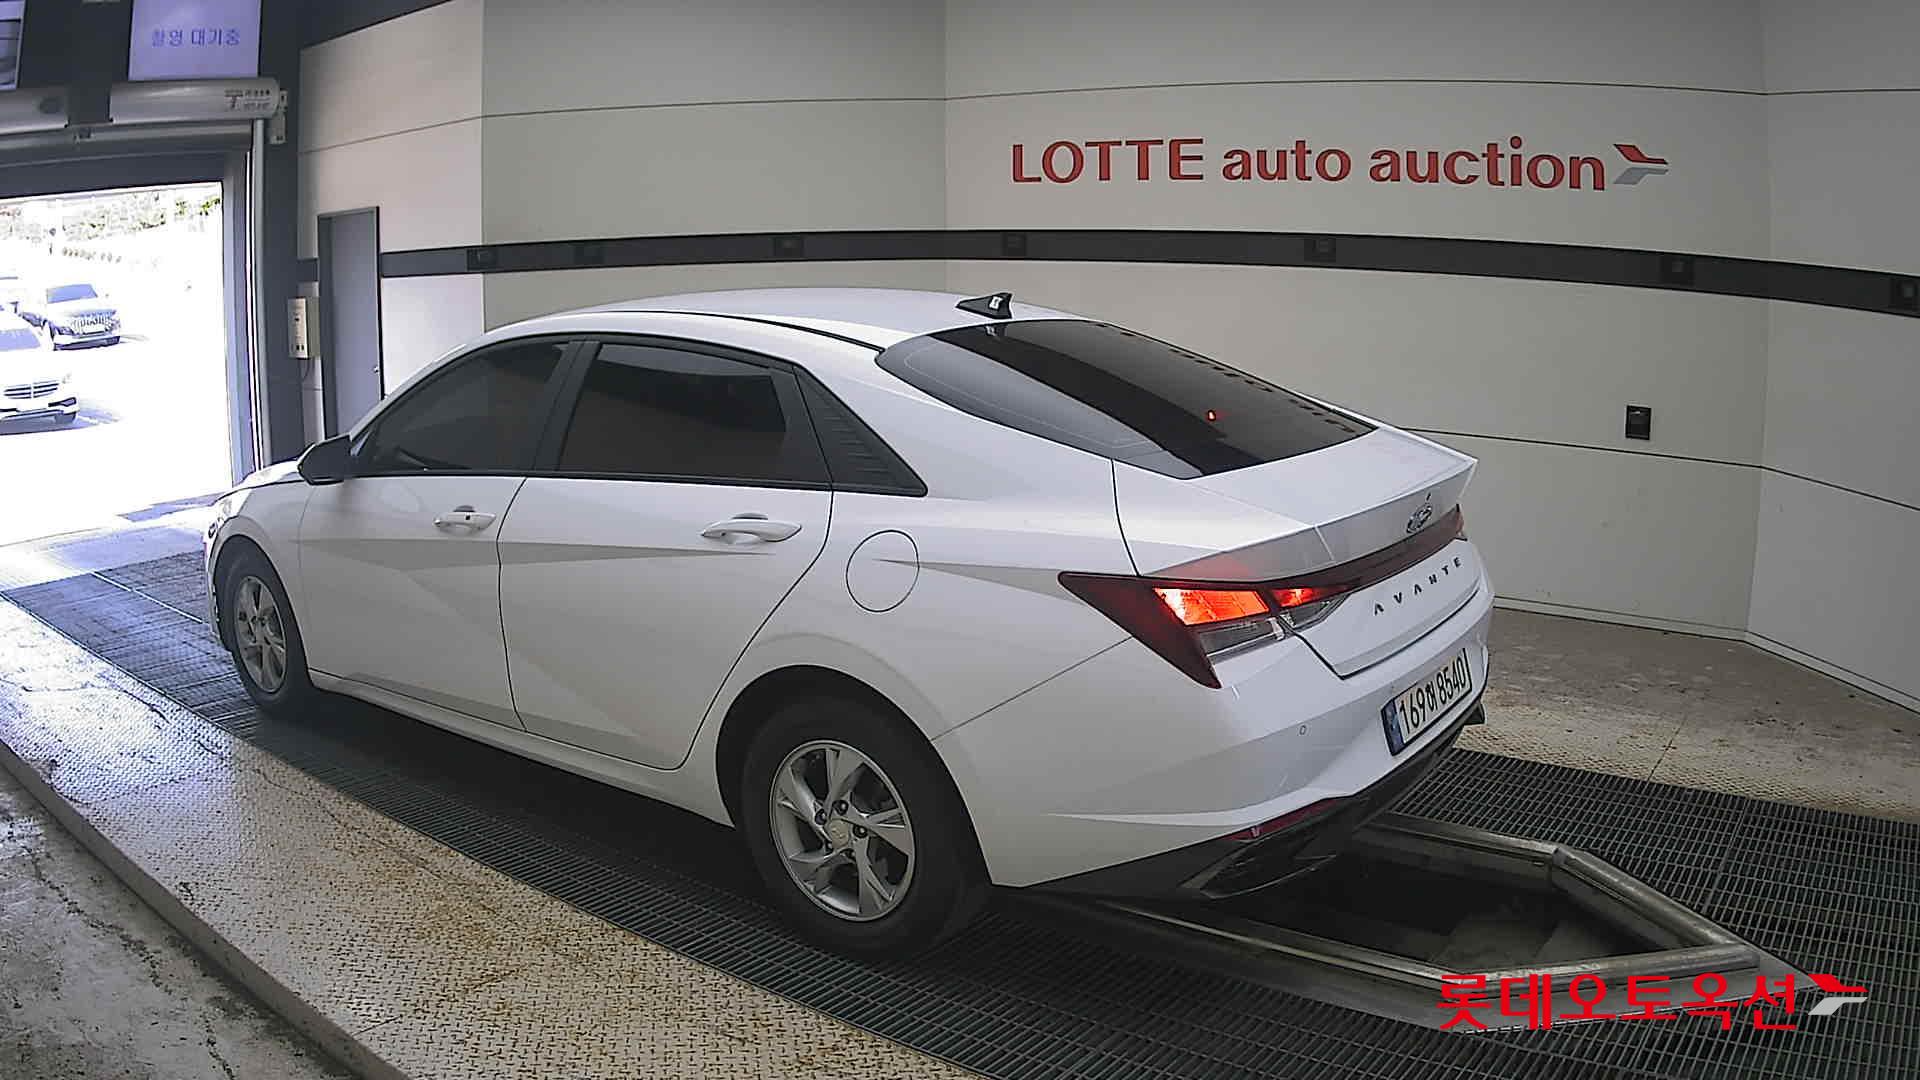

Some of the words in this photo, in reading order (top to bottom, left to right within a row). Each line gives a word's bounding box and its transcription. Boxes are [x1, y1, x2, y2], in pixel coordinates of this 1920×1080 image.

[1012, 138, 1204, 183] LOTTE
[1222, 139, 1351, 182] auto
[1369, 136, 1605, 191] auction
[1374, 557, 1461, 616] AVANTE
